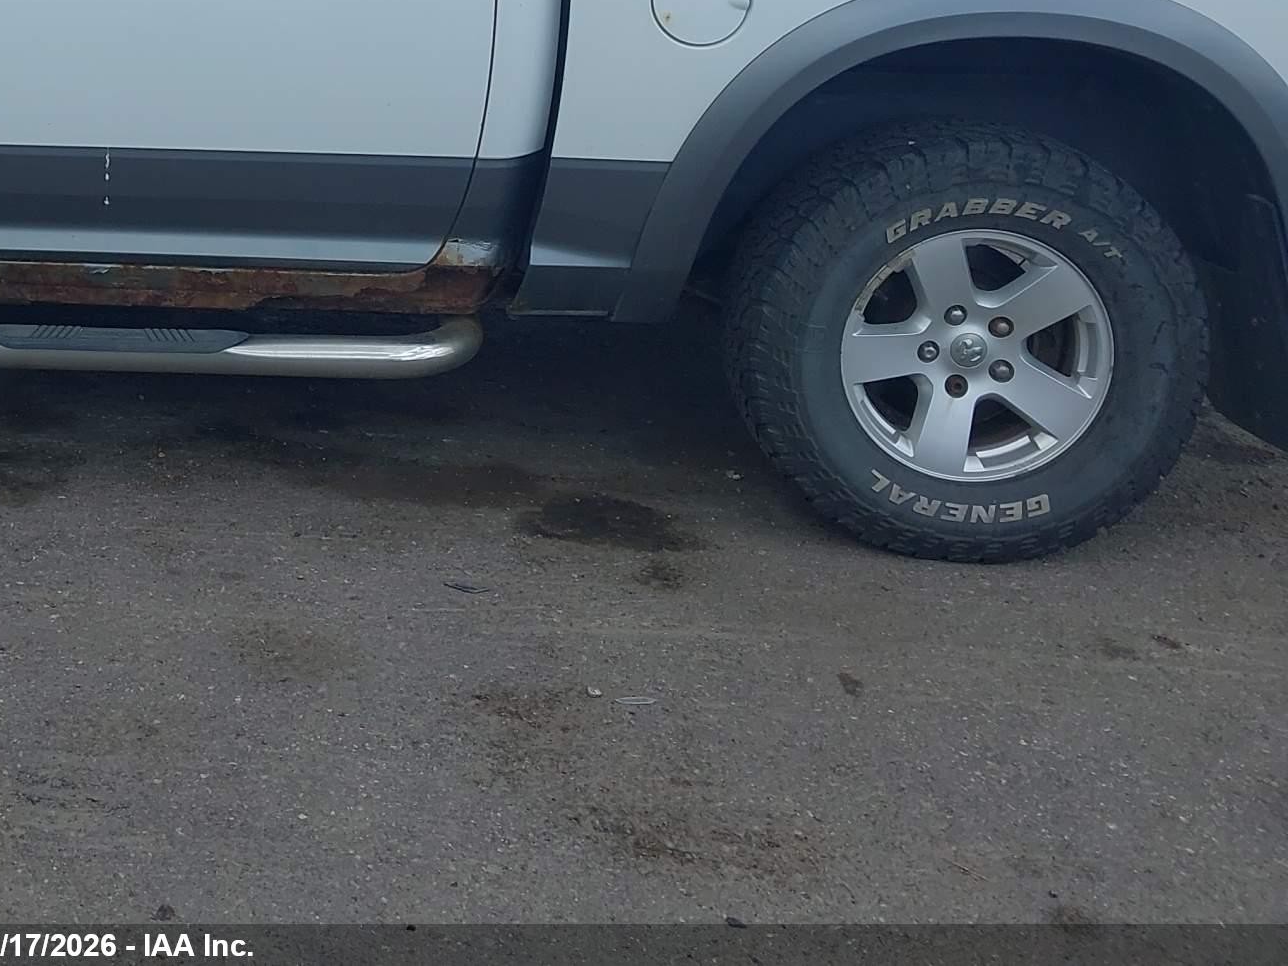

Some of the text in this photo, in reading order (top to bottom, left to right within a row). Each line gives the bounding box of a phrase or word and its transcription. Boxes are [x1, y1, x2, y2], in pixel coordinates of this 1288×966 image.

[886, 198, 1124, 259] GRABBER A/T
[871, 469, 1050, 523] GENERAL
